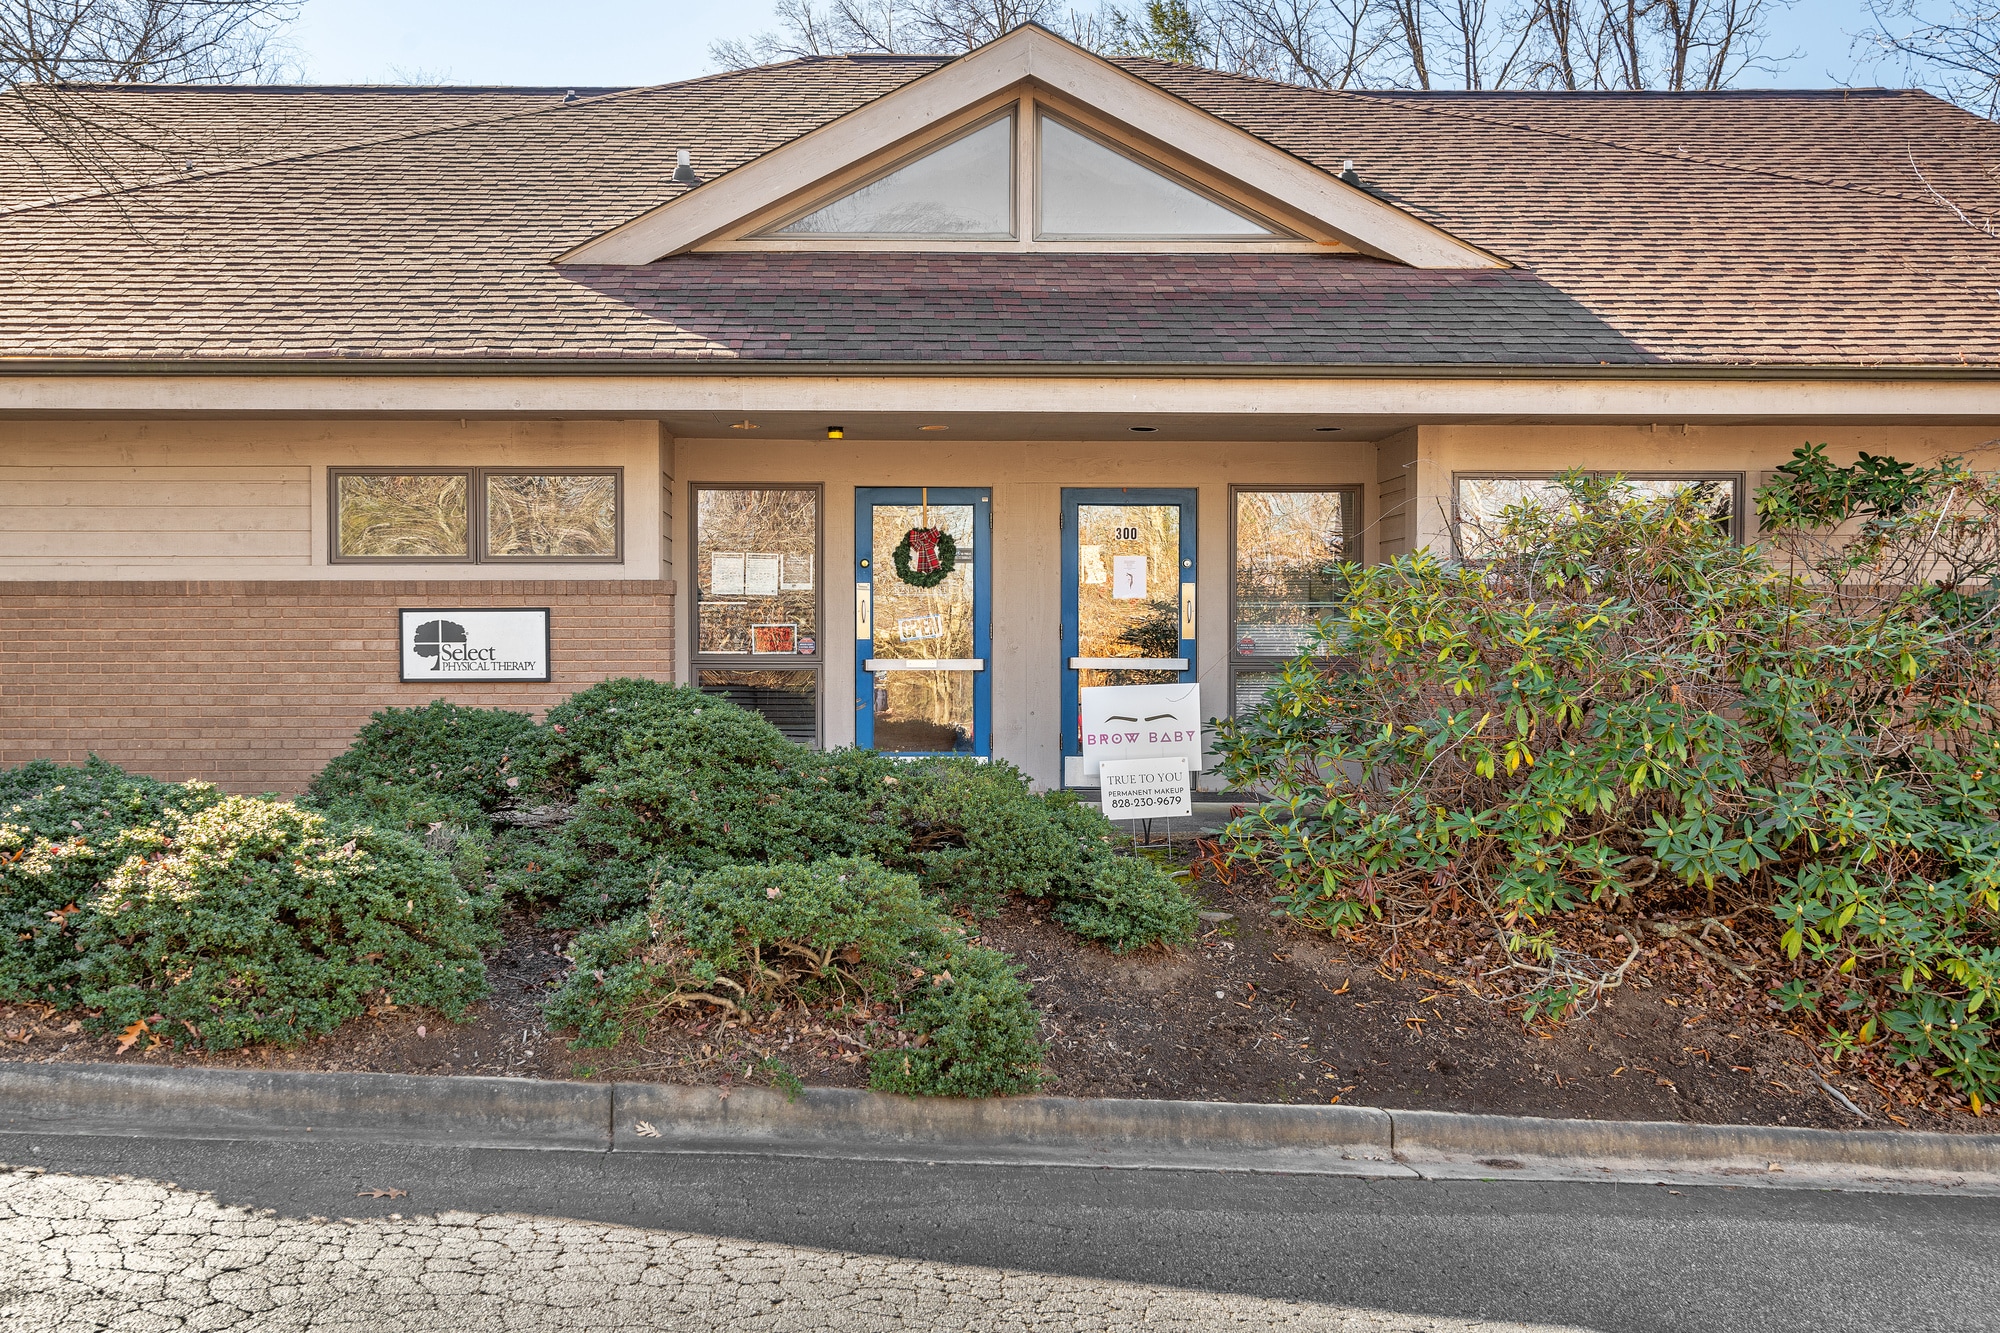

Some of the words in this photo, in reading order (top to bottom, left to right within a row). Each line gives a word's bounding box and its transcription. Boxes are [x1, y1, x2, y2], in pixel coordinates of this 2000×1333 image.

[1115, 527, 1137, 540] 300
[441, 643, 496, 661] Select
[442, 661, 490, 671] PHYSICAL
[491, 661, 536, 671] THERAPY
[1087, 732, 1140, 745] BROW
[1149, 730, 1196, 743] BABY
[1107, 774, 1137, 785] TRUE
[1139, 773, 1155, 784] TO
[1157, 772, 1183, 782] YOU
[1108, 788, 1152, 798] PERMANENT
[1154, 787, 1184, 795] MAKEUP
[1111, 796, 1182, 809] 828-230-9679
